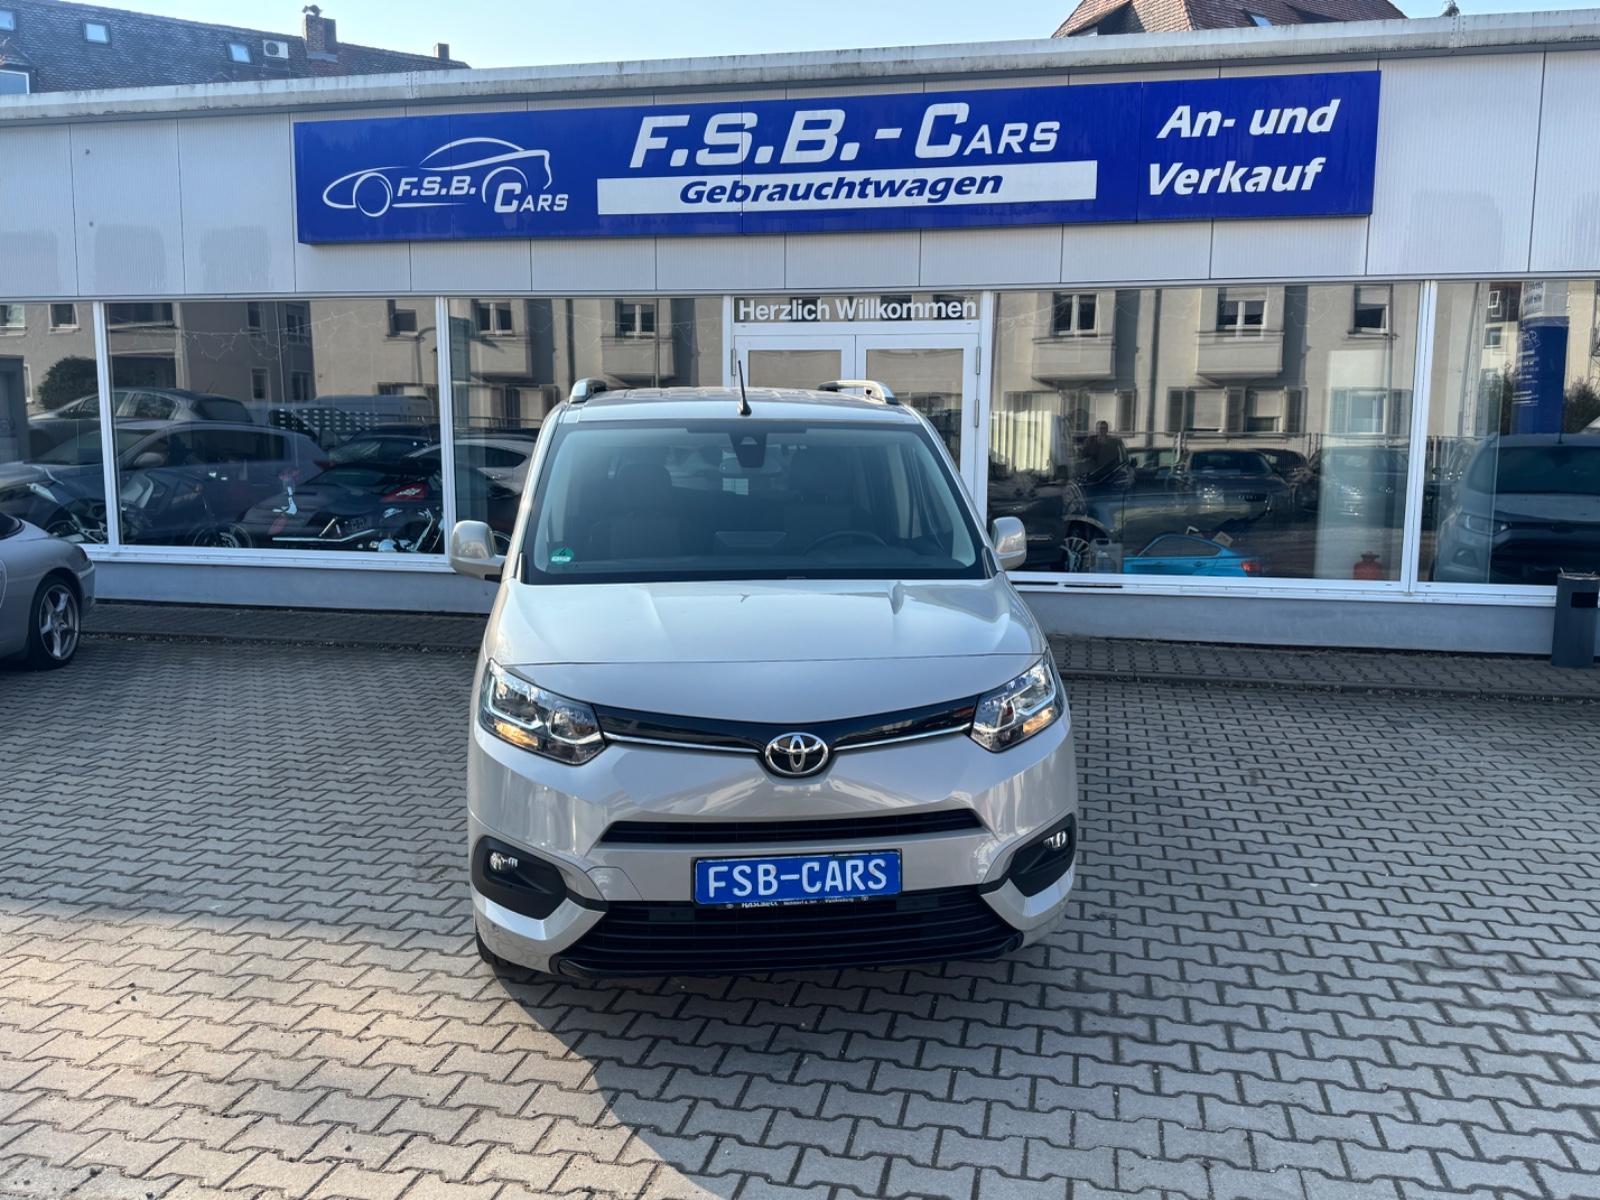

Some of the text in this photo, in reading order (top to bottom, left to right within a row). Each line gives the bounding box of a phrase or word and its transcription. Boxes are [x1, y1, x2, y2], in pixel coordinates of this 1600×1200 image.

[914, 102, 1061, 159] CARS
[1156, 98, 1341, 139] An- und
[396, 175, 569, 214] F.S.B. CARS
[679, 172, 1004, 206] Gebrauchtwagen
[1149, 156, 1327, 196] Verkauf
[738, 298, 978, 321] Herzlich Willkommen
[708, 858, 888, 898] FSB-CARS
